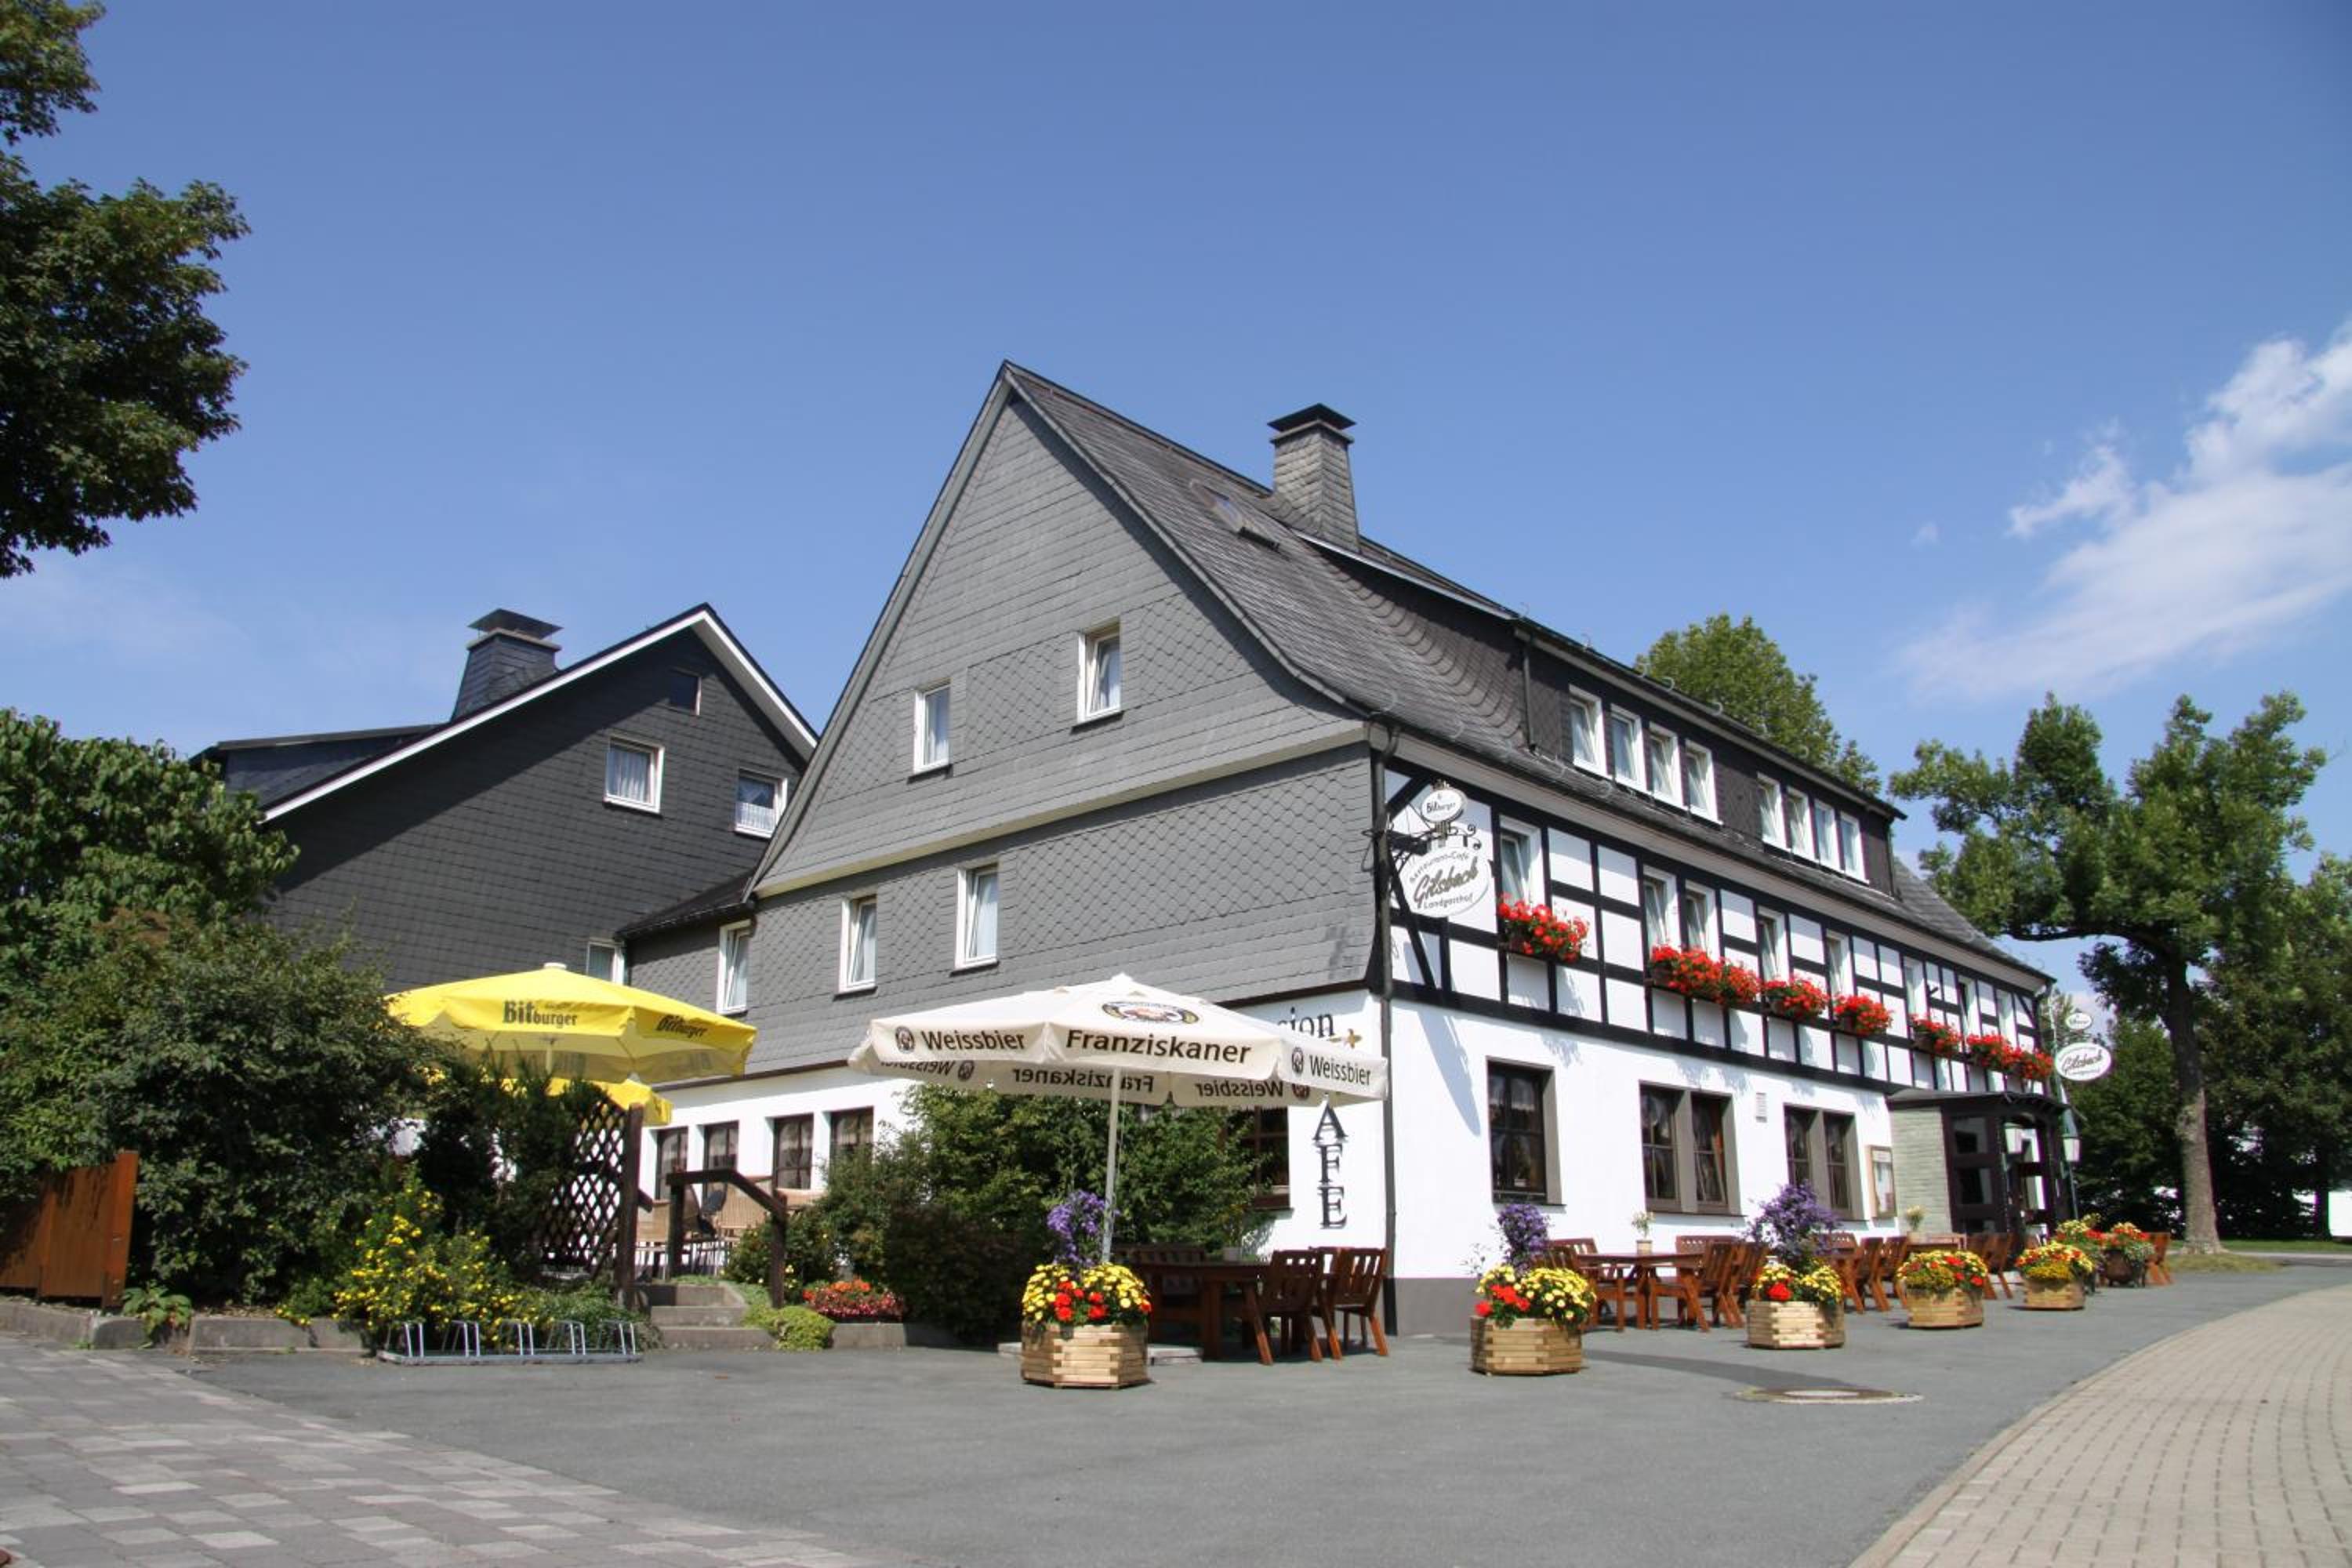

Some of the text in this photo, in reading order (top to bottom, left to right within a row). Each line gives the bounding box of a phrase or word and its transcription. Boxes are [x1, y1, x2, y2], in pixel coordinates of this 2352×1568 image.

[503, 1000, 579, 1029] Bitburger
[1277, 1007, 1336, 1039] ion
[920, 1029, 1026, 1052] Weissbier
[1065, 1029, 1252, 1065] Franziskaner
[1309, 1054, 1372, 1087] Weissbier
[1312, 1100, 1348, 1230] AFE
